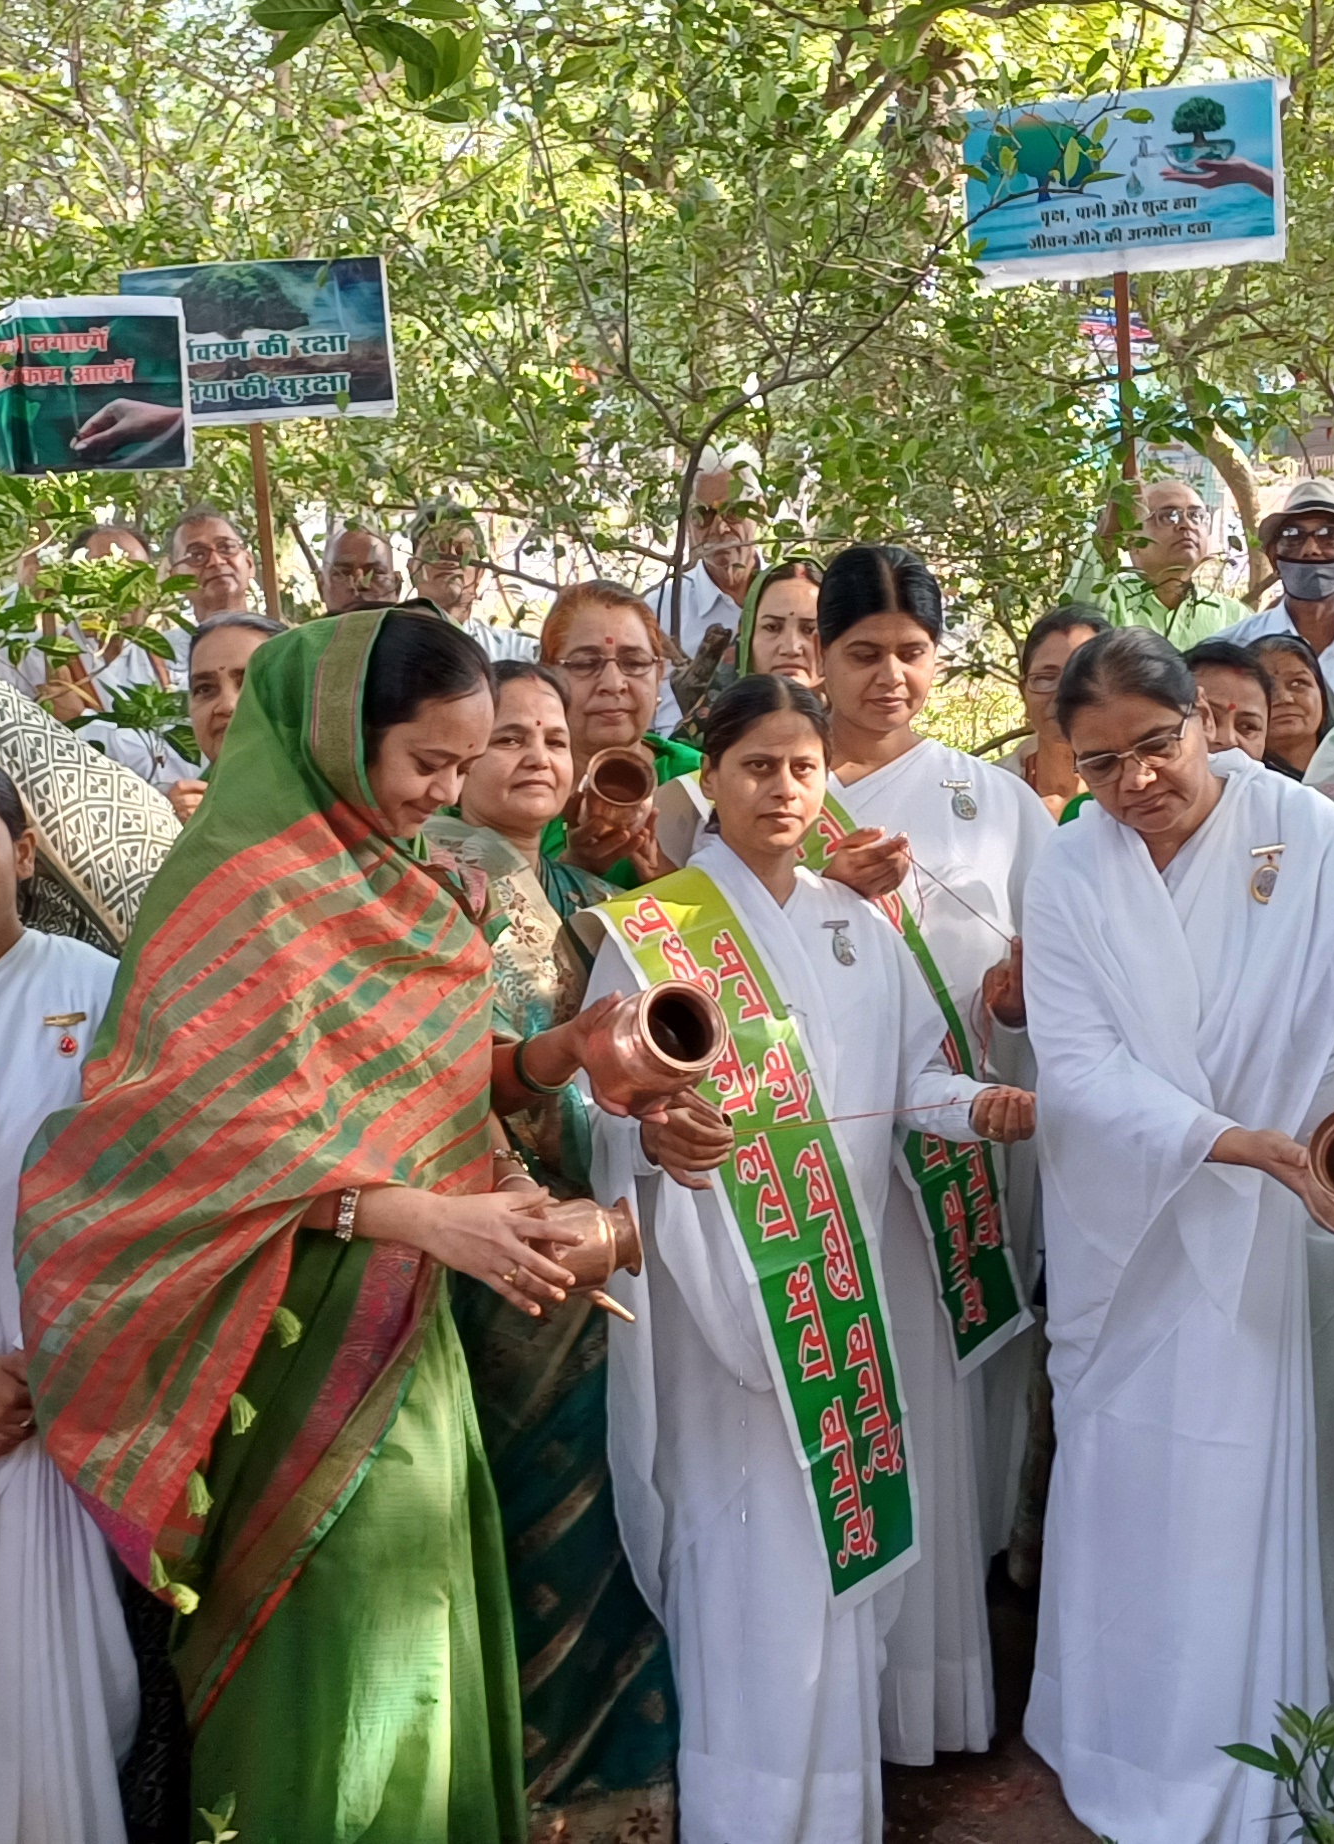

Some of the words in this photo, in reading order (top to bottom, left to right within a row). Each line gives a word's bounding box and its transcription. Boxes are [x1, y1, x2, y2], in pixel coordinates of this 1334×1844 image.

[1076, 201, 1107, 219] पानी
[1111, 198, 1138, 217] और
[1142, 199, 1170, 218] शुद्ध
[1173, 196, 1199, 210] हवा
[1028, 234, 1068, 250] जीवन
[1071, 228, 1101, 245] जीने
[1104, 226, 1122, 243] की
[1127, 221, 1184, 240] अनमोल
[1187, 220, 1213, 236] दवा
[254, 332, 290, 357] की
[298, 333, 349, 355] रक्षा
[233, 372, 269, 399] की
[274, 373, 350, 403] सुरक्षा
[712, 929, 772, 1023] मन
[761, 1039, 812, 1124] को
[735, 1132, 801, 1243] हरा
[785, 1261, 837, 1383] भरा
